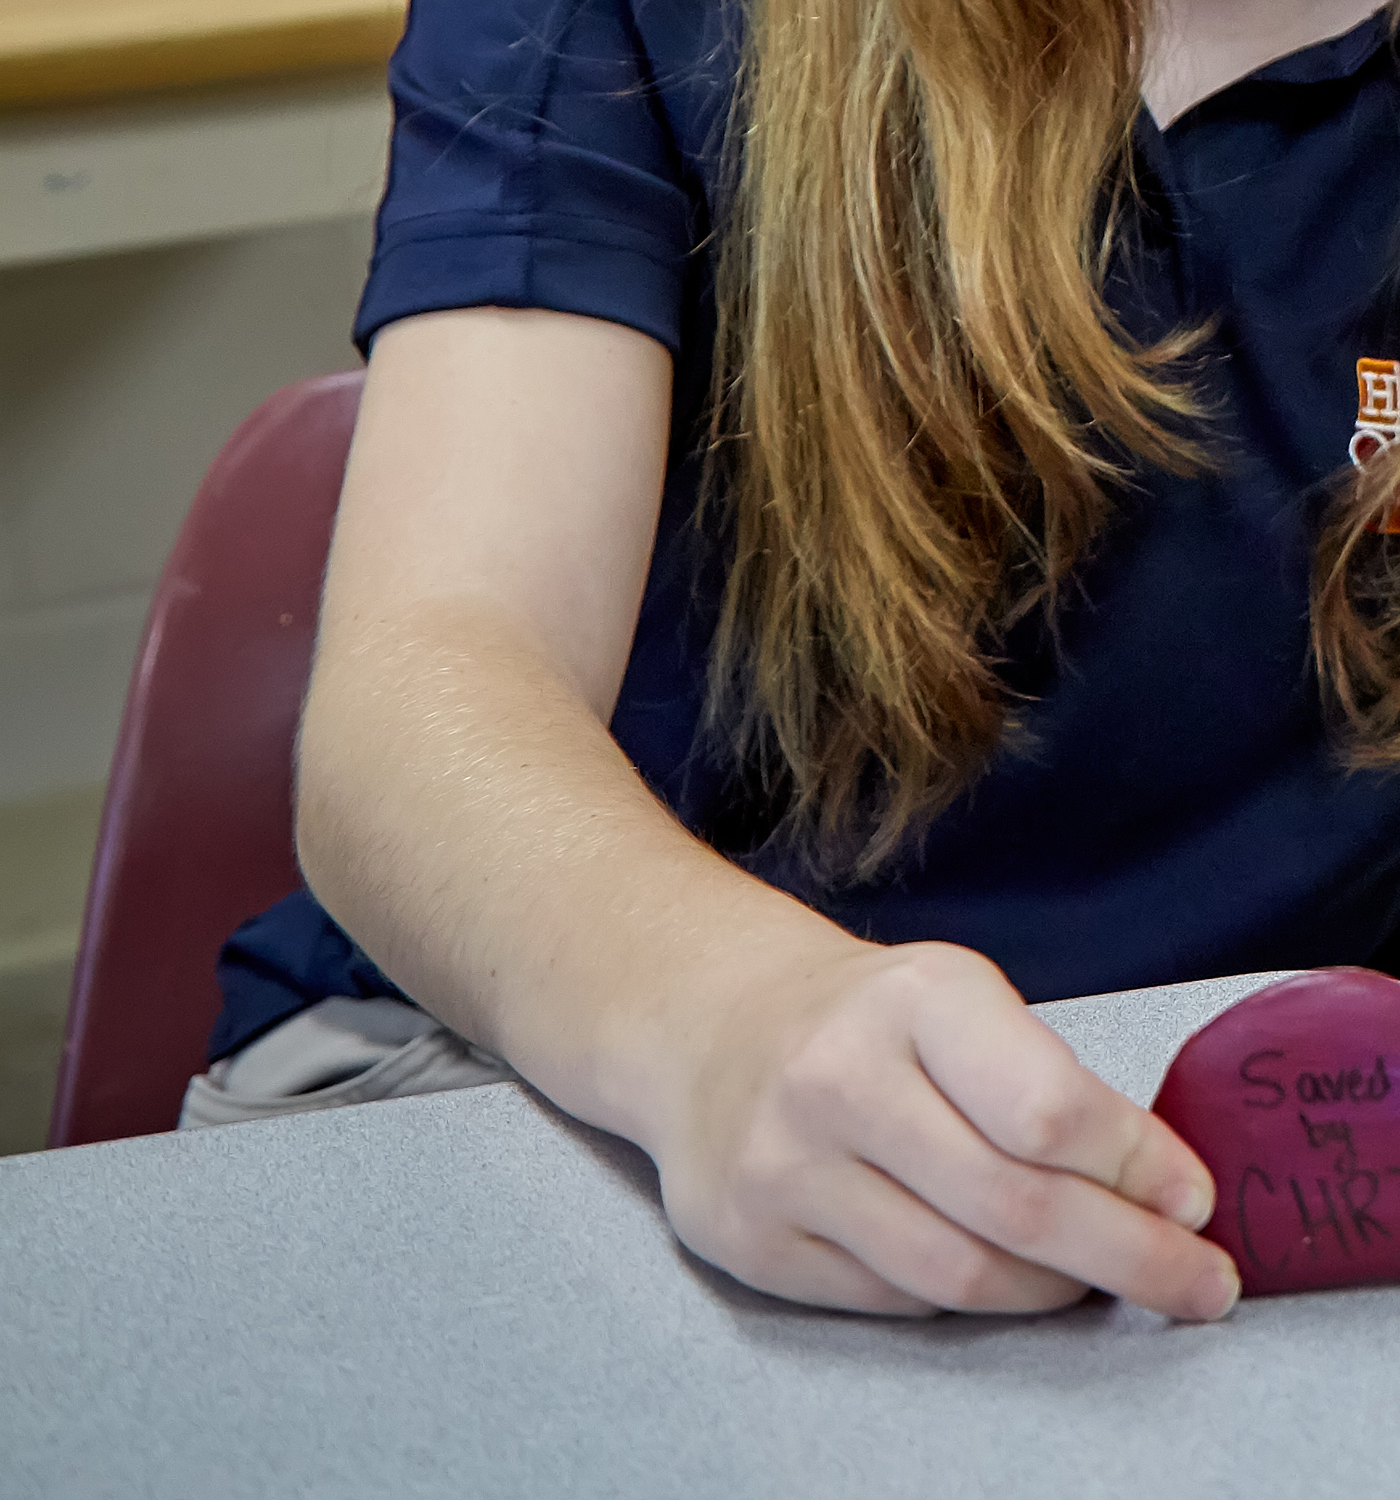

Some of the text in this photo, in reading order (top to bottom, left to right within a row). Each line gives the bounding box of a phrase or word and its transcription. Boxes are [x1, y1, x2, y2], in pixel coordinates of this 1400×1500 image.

[1361, 371, 1399, 417] H
[1239, 1048, 1392, 1110] Saved
[1299, 1112, 1358, 1176] by
